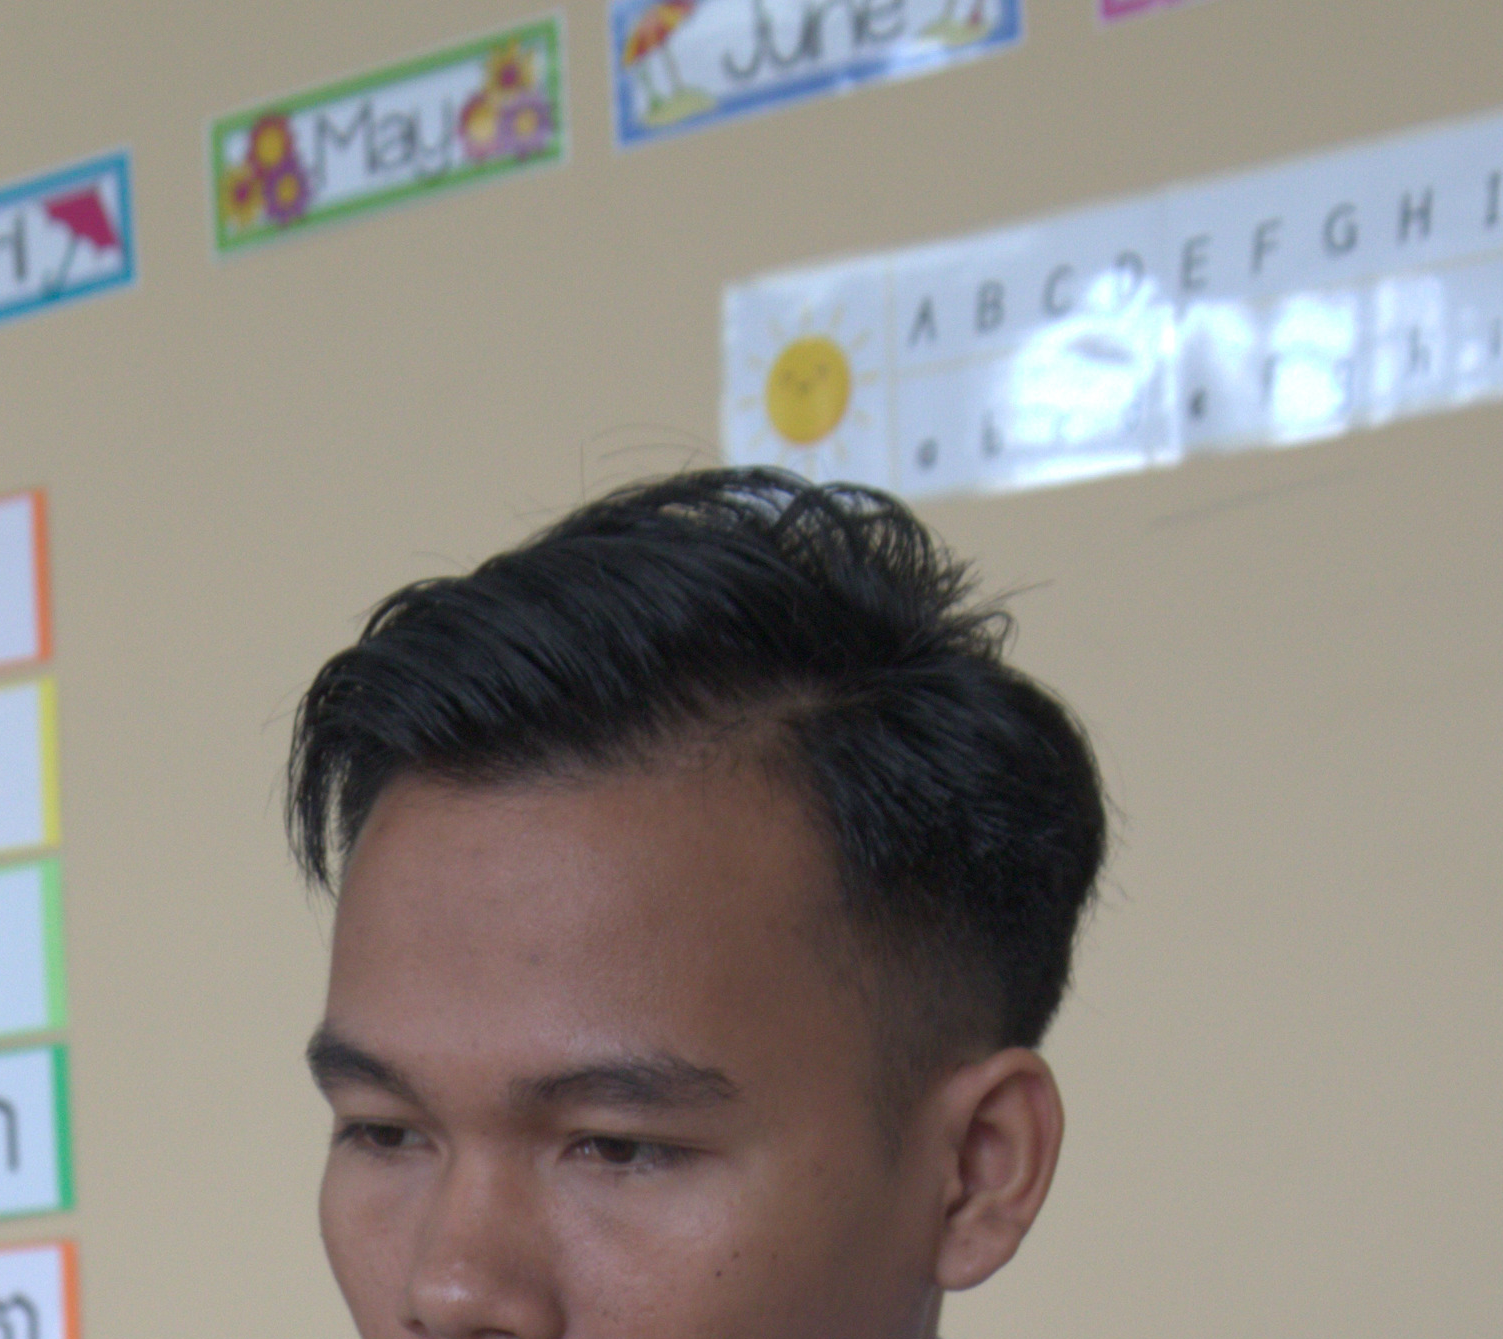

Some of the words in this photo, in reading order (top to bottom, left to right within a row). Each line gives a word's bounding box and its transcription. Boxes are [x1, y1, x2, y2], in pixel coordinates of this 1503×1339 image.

[311, 102, 456, 188] May
[907, 298, 937, 347] A
[975, 279, 1005, 334] B
[1042, 263, 1073, 318] C
[1181, 234, 1213, 293] E
[1250, 217, 1283, 275] F
[1321, 203, 1358, 257] G
[1397, 186, 1436, 246] H
[1484, 170, 1502, 228] I
